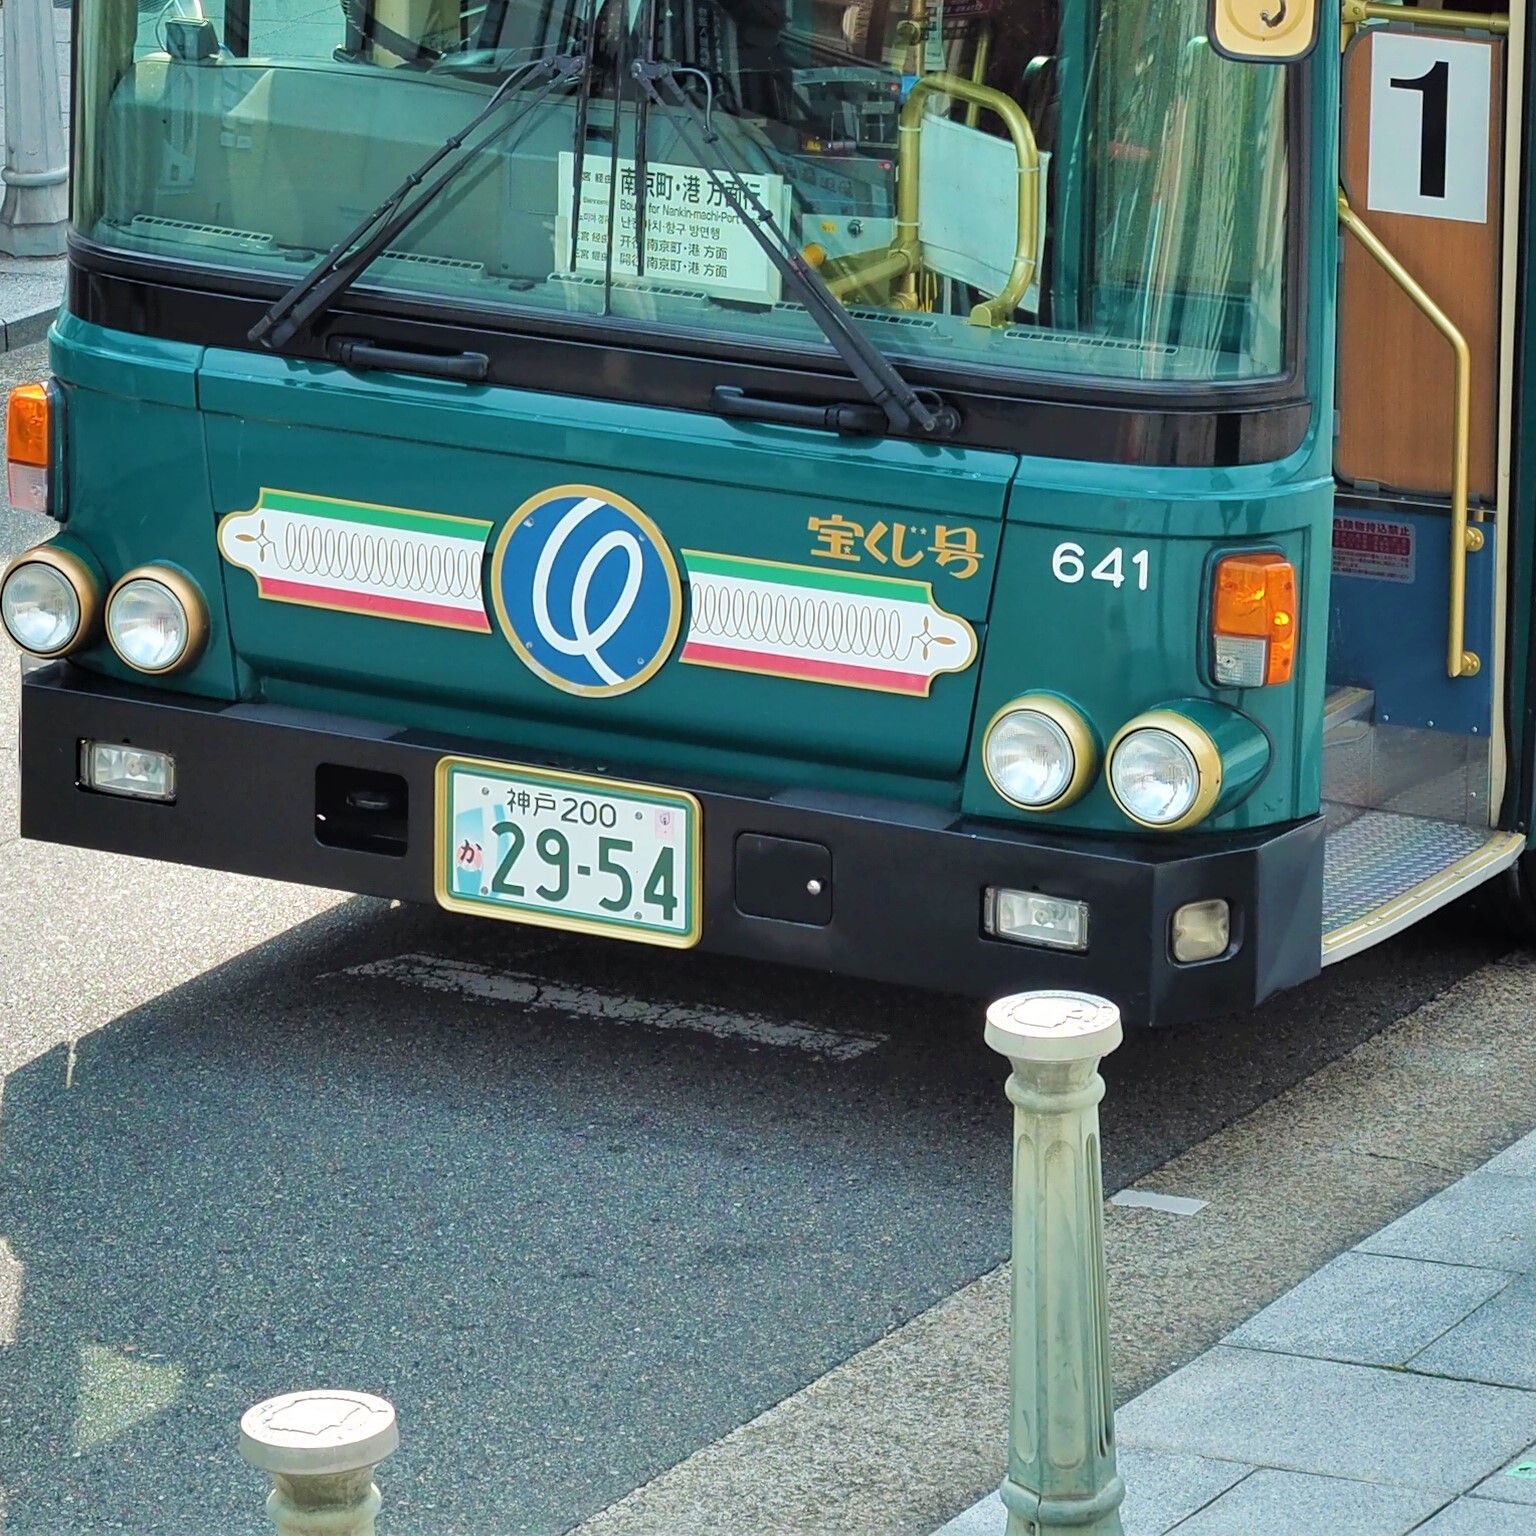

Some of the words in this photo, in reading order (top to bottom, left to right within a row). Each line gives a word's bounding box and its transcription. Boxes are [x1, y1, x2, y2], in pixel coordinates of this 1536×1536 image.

[1389, 60, 1450, 200] 1
[648, 202, 661, 215] for
[808, 514, 984, 580] 宝くじ号
[1052, 541, 1149, 592] 641
[506, 787, 557, 817] 神戸
[561, 797, 617, 829] 200
[459, 839, 483, 864] か
[490, 820, 678, 922] 29-54
